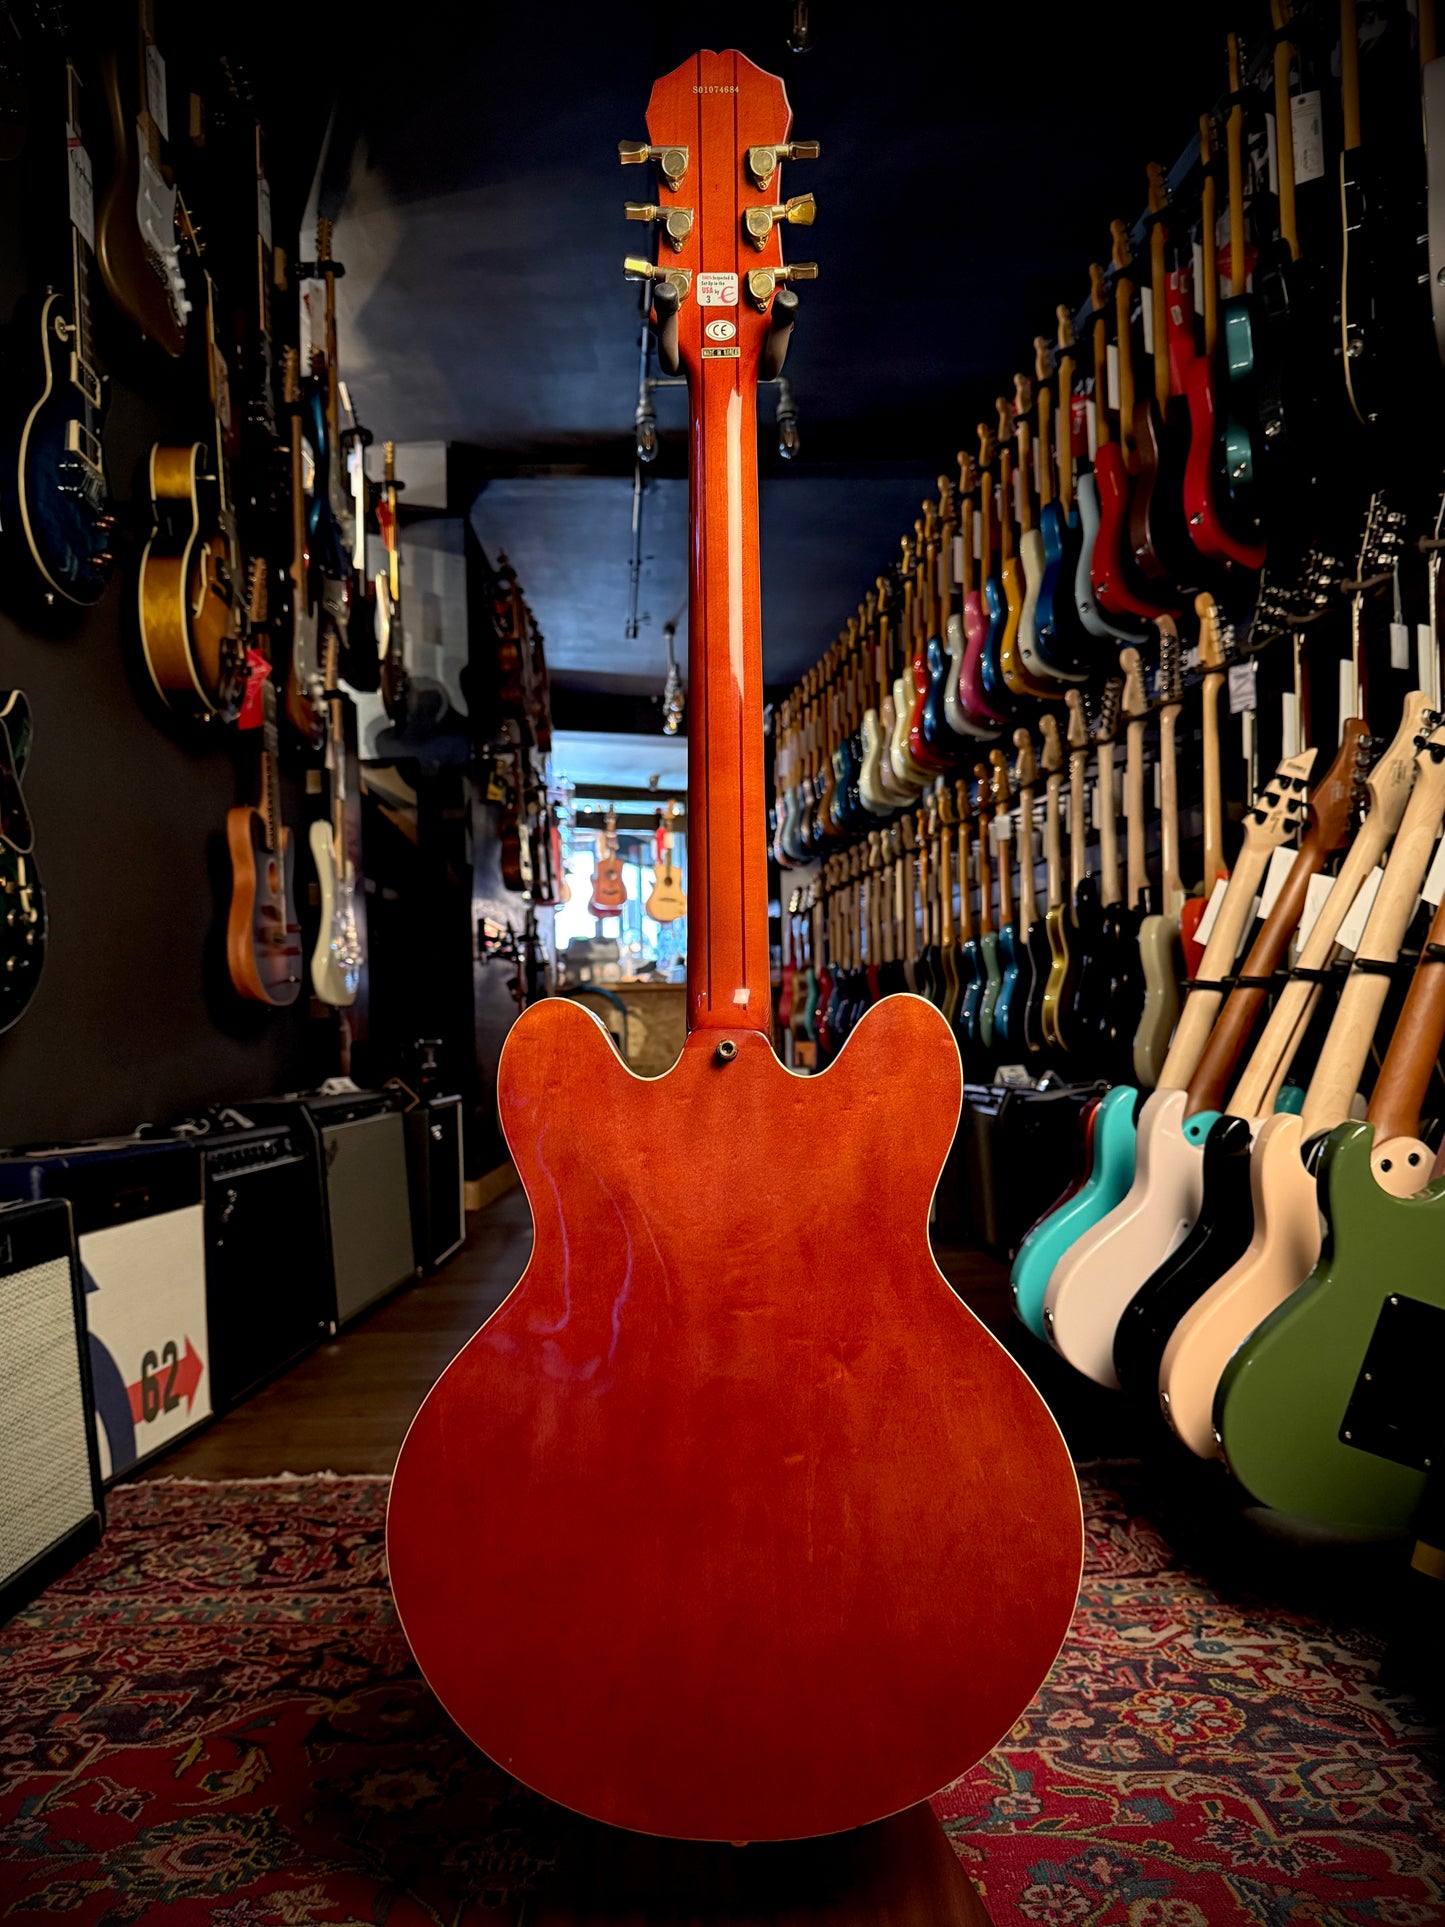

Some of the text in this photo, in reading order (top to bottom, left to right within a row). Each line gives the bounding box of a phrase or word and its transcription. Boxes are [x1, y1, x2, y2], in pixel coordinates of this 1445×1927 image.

[692, 85, 739, 94] S01074684
[706, 295, 711, 304] 3
[713, 324, 727, 336] CE
[141, 1340, 180, 1424] 62
